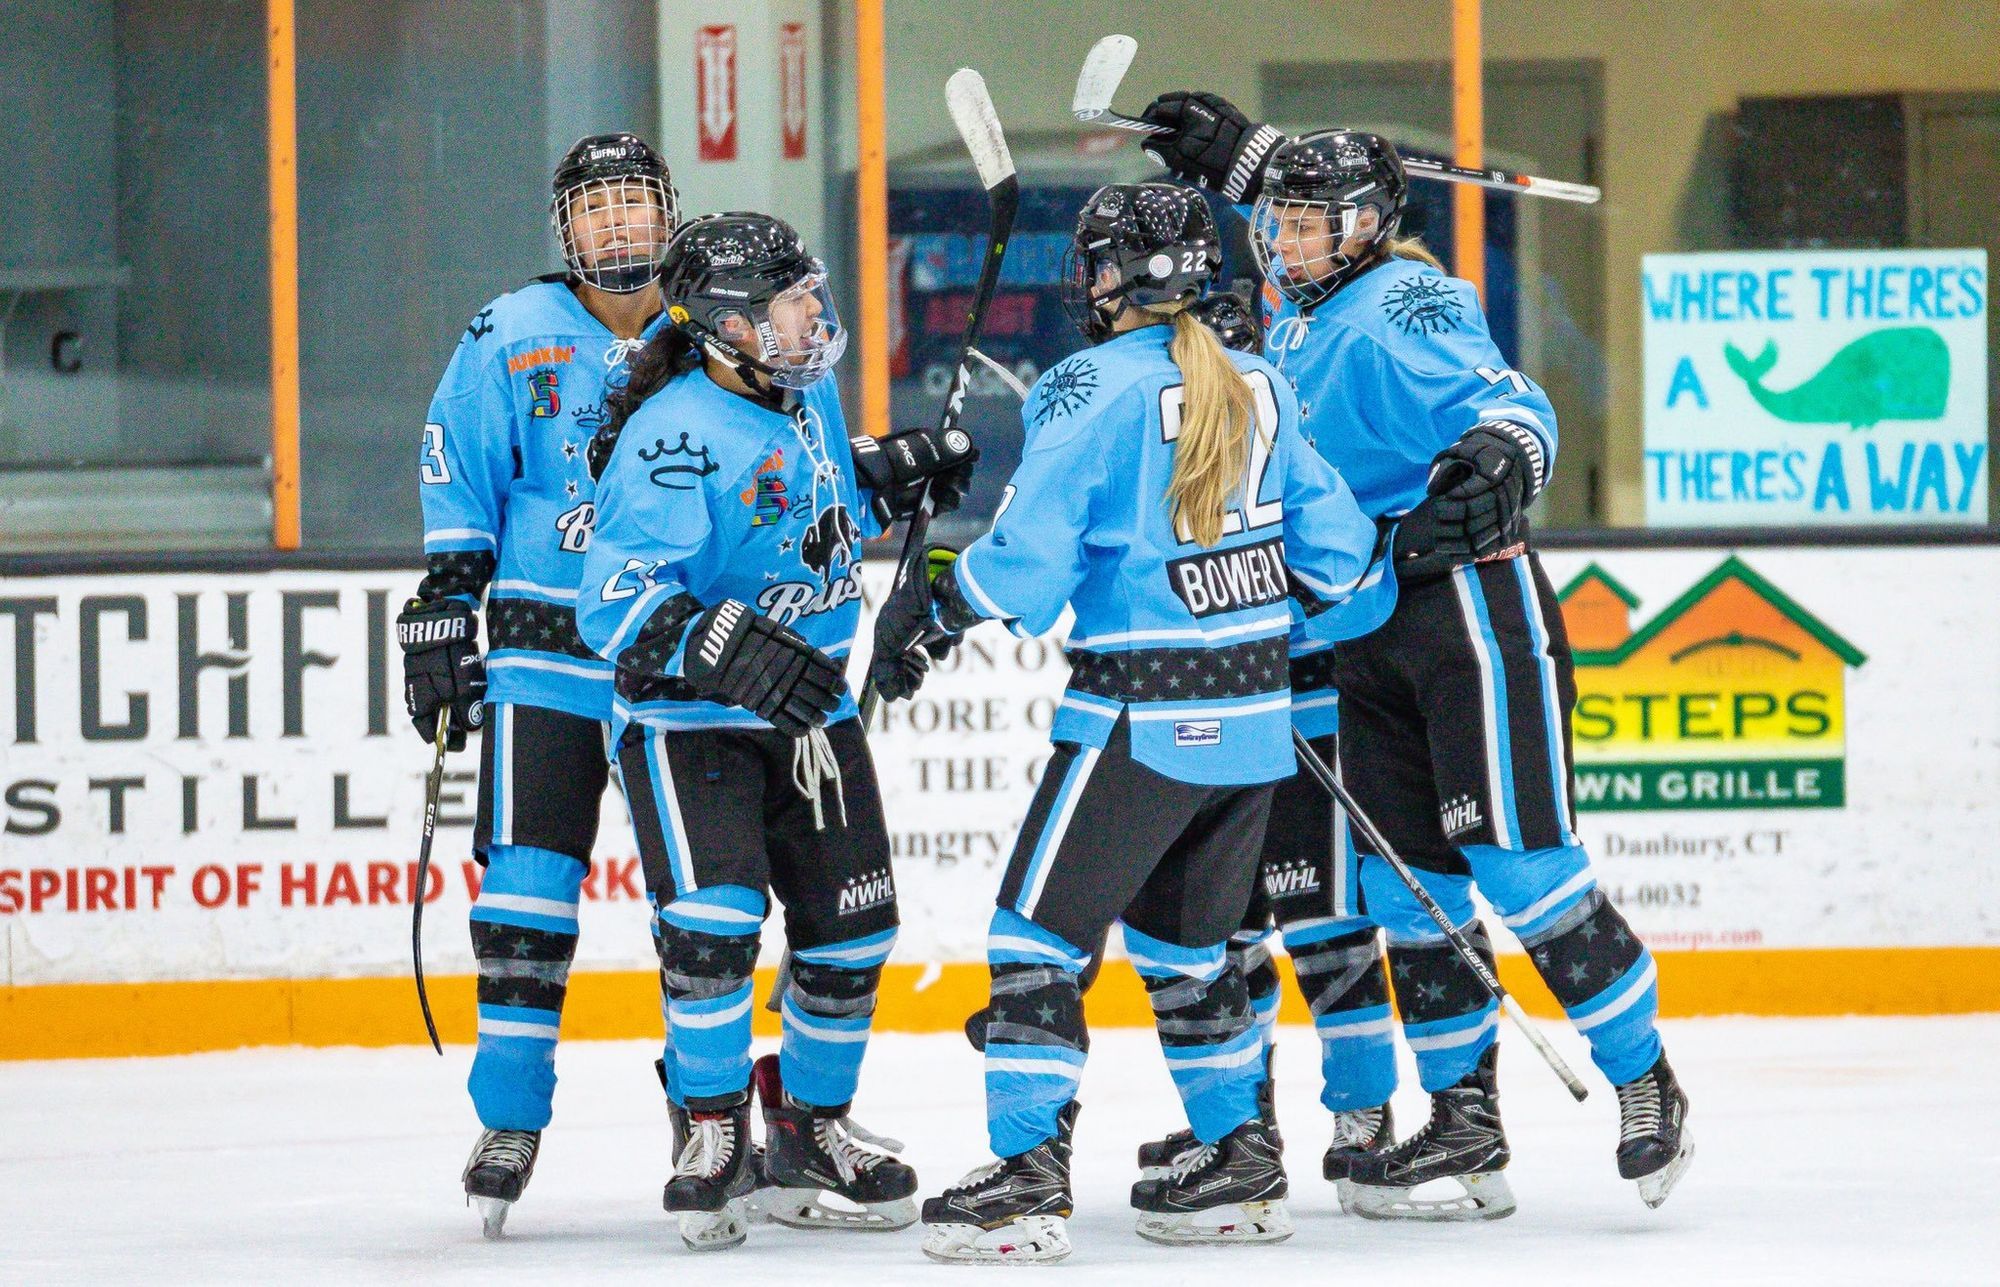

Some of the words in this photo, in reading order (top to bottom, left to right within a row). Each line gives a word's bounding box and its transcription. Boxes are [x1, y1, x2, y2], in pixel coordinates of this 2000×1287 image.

[590, 147, 627, 160] BUFFALO
[1181, 251, 1208, 273] 22
[1642, 269, 1795, 322] WHERE
[759, 320, 780, 357] BUFFALO
[1666, 354, 1709, 410] A
[1813, 442, 1851, 511] A
[1865, 441, 1986, 512] WAY
[1575, 690, 1831, 741] STEPS
[911, 754, 1008, 791] THE
[1656, 768, 1822, 801] GRILLE
[1605, 834, 1736, 861] Danbury,
[1744, 832, 1790, 855] CT
[0, 865, 174, 915] SPIRIT
[191, 863, 263, 909] OF
[280, 859, 444, 907] HARD
[839, 875, 894, 911] NWHL
[1463, 946, 1500, 988] BAUER
